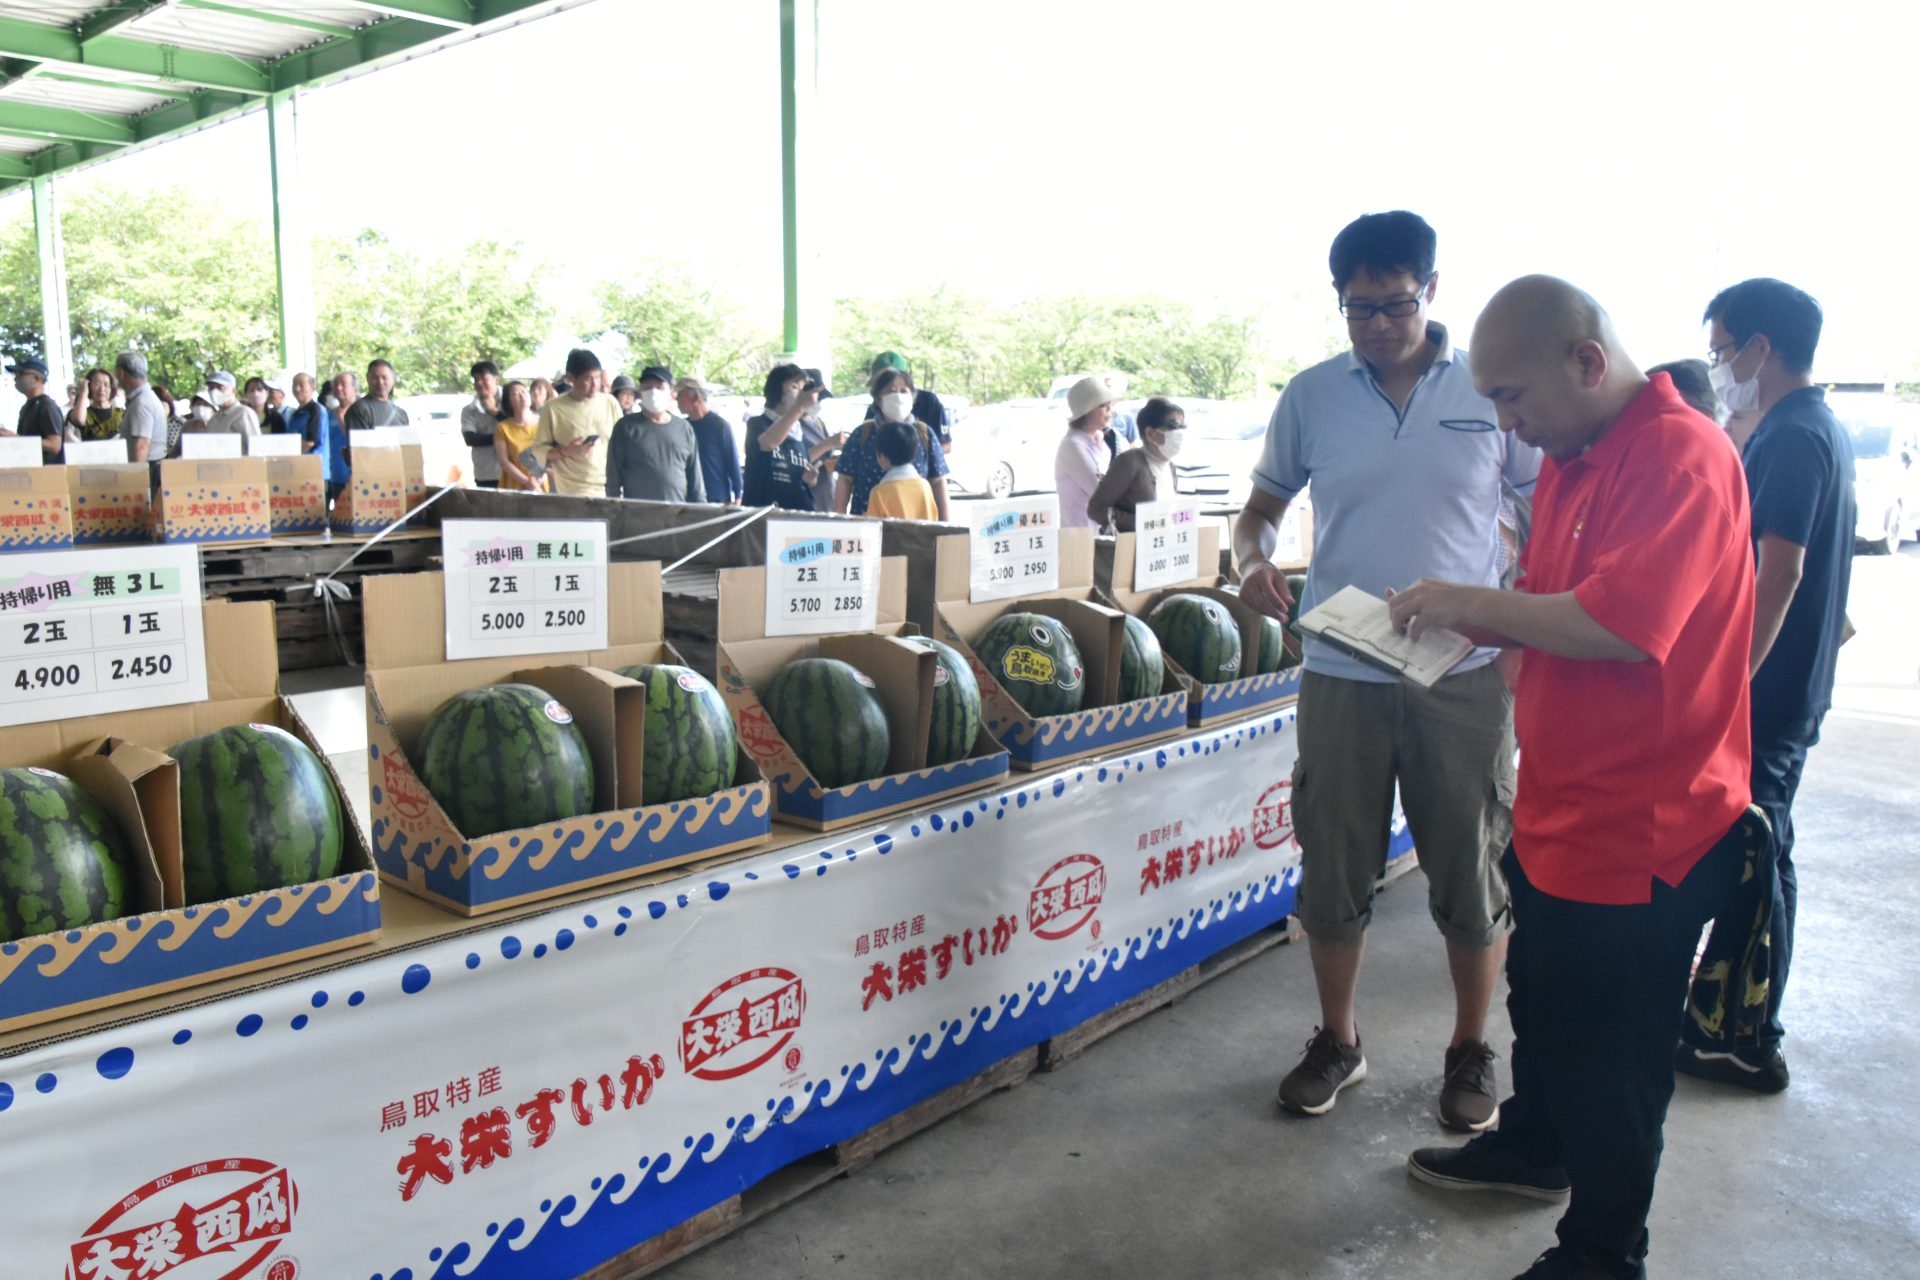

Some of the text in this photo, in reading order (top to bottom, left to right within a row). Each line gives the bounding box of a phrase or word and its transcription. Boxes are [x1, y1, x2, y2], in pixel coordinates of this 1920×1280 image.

[475, 545, 524, 566] 持帰り用
[797, 567, 860, 582] 2玉 1玉
[0, 580, 72, 611] 持帰り用
[489, 574, 580, 593] 2玉 1玉
[23, 611, 161, 645] 2玉 1玉
[1140, 827, 1245, 896] 大栄すいか
[1032, 868, 1101, 923] 大栄西瓜
[855, 914, 926, 958] 鳥取特産
[861, 914, 1018, 1011] 大栄すいか
[686, 984, 800, 1063] 大栄西瓜
[380, 1066, 502, 1132] 鳥取特産
[397, 1053, 665, 1201] 大栄すいか
[79, 1176, 287, 1280] 大栄西瓜
